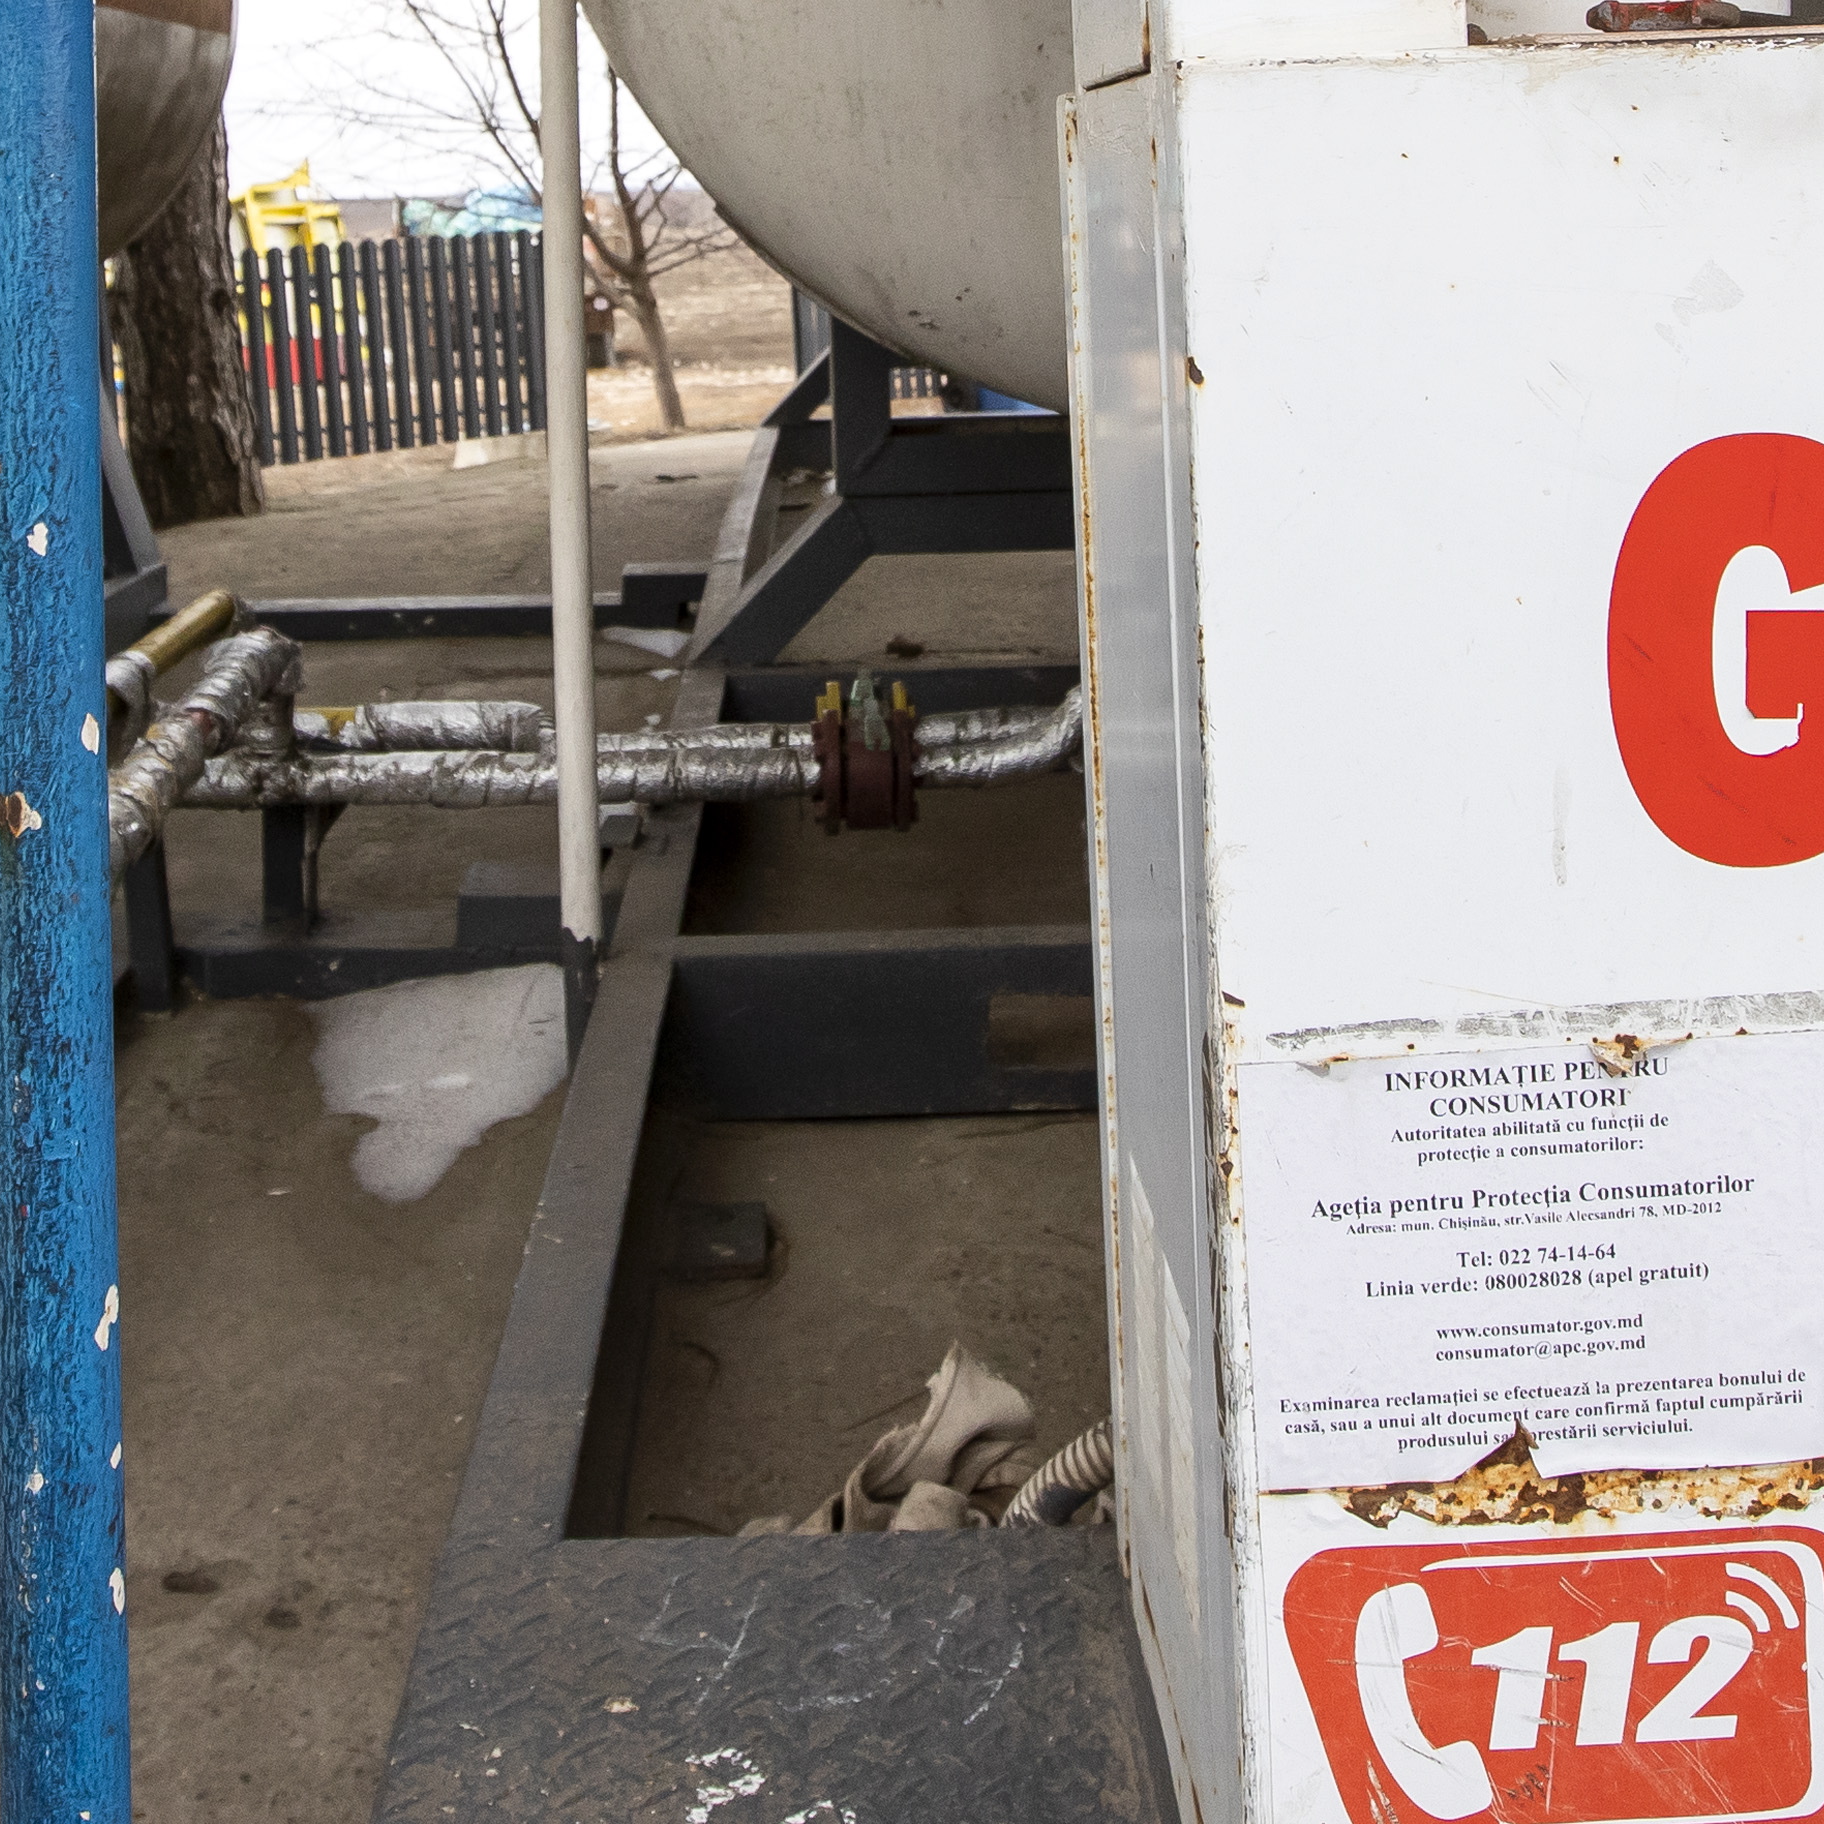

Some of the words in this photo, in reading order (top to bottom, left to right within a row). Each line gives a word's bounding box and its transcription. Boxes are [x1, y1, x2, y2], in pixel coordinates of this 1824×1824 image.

[1563, 1054, 1668, 1081] PENRU
[1429, 1087, 1629, 1117] CONSUMATORI
[1390, 1124, 1486, 1142] Autoritatea
[1492, 1118, 1560, 1136] abilitată
[1565, 1120, 1584, 1132] cu
[1649, 1112, 1668, 1127] de
[1495, 1147, 1504, 1158] a
[1510, 1136, 1643, 1157] consumatorilor:
[1388, 1193, 1463, 1218] pentru
[1578, 1174, 1755, 1202] Consumatorilor
[1455, 1250, 1492, 1268] Tel:
[1498, 1247, 1531, 1266] 022
[1536, 1242, 1616, 1264] 74-14-64
[1365, 1279, 1414, 1297] Linia
[1419, 1276, 1478, 1294] verde:
[1484, 1268, 1582, 1291] 080028028
[1587, 1265, 1632, 1288] (apel
[1638, 1261, 1709, 1286] gratuit)
[1435, 1314, 1643, 1339] www.consumator.gov.md
[1435, 1334, 1645, 1361] consumator@apc.gov.md
[1279, 1395, 1380, 1413] Examinarea
[1482, 1390, 1499, 1401] se
[1503, 1381, 1590, 1400] efectuează
[1595, 1380, 1610, 1394] la
[1615, 1376, 1713, 1396] prezentarea
[1718, 1369, 1782, 1387] bonului
[1786, 1367, 1806, 1383] de
[1284, 1418, 1325, 1435] casă,
[1329, 1419, 1357, 1432] sau
[1362, 1419, 1372, 1430] a
[1378, 1412, 1415, 1429] unui
[1420, 1411, 1441, 1426] alt
[1446, 1407, 1528, 1425] document
[1534, 1407, 1570, 1420] care
[1574, 1398, 1650, 1417] confirmă
[1655, 1394, 1704, 1415] faptul
[1709, 1388, 1802, 1411] cumpărării
[1397, 1429, 1488, 1452] produsului
[1601, 1417, 1693, 1437] serviciului.
[1470, 1614, 1754, 1752] 112
